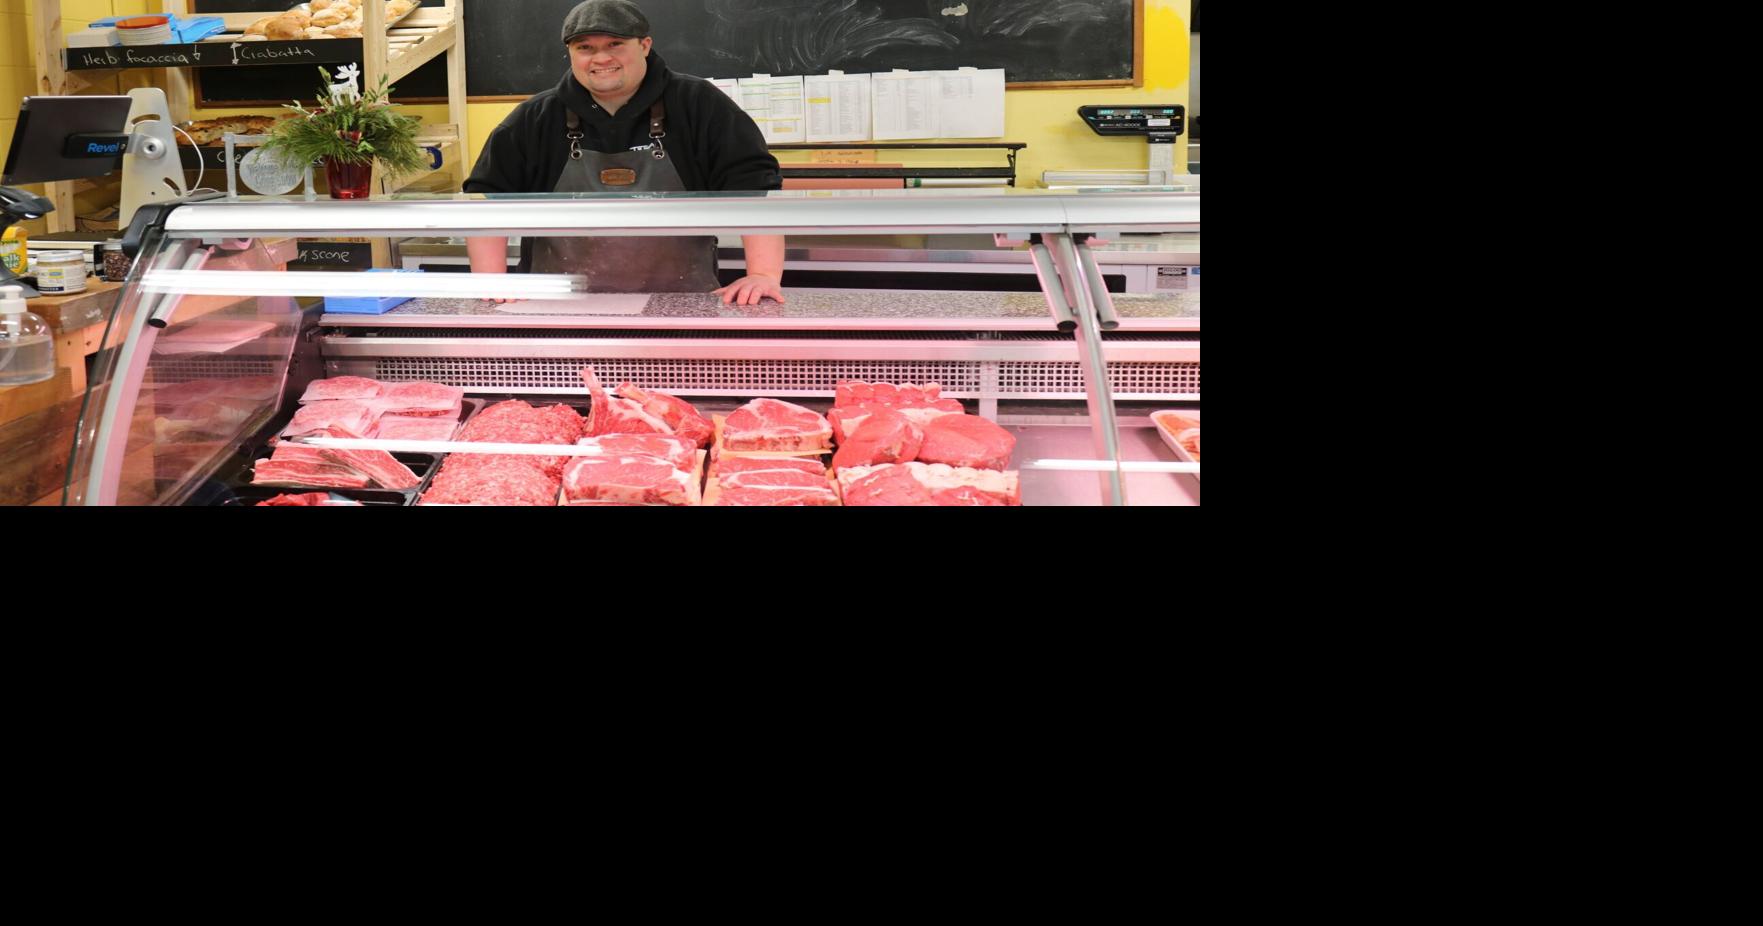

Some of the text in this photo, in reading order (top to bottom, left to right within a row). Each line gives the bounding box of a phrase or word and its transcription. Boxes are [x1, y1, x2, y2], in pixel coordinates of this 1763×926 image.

[126, 49, 189, 63] focaccia
[87, 142, 120, 153] Revel
[311, 249, 350, 263] scone
